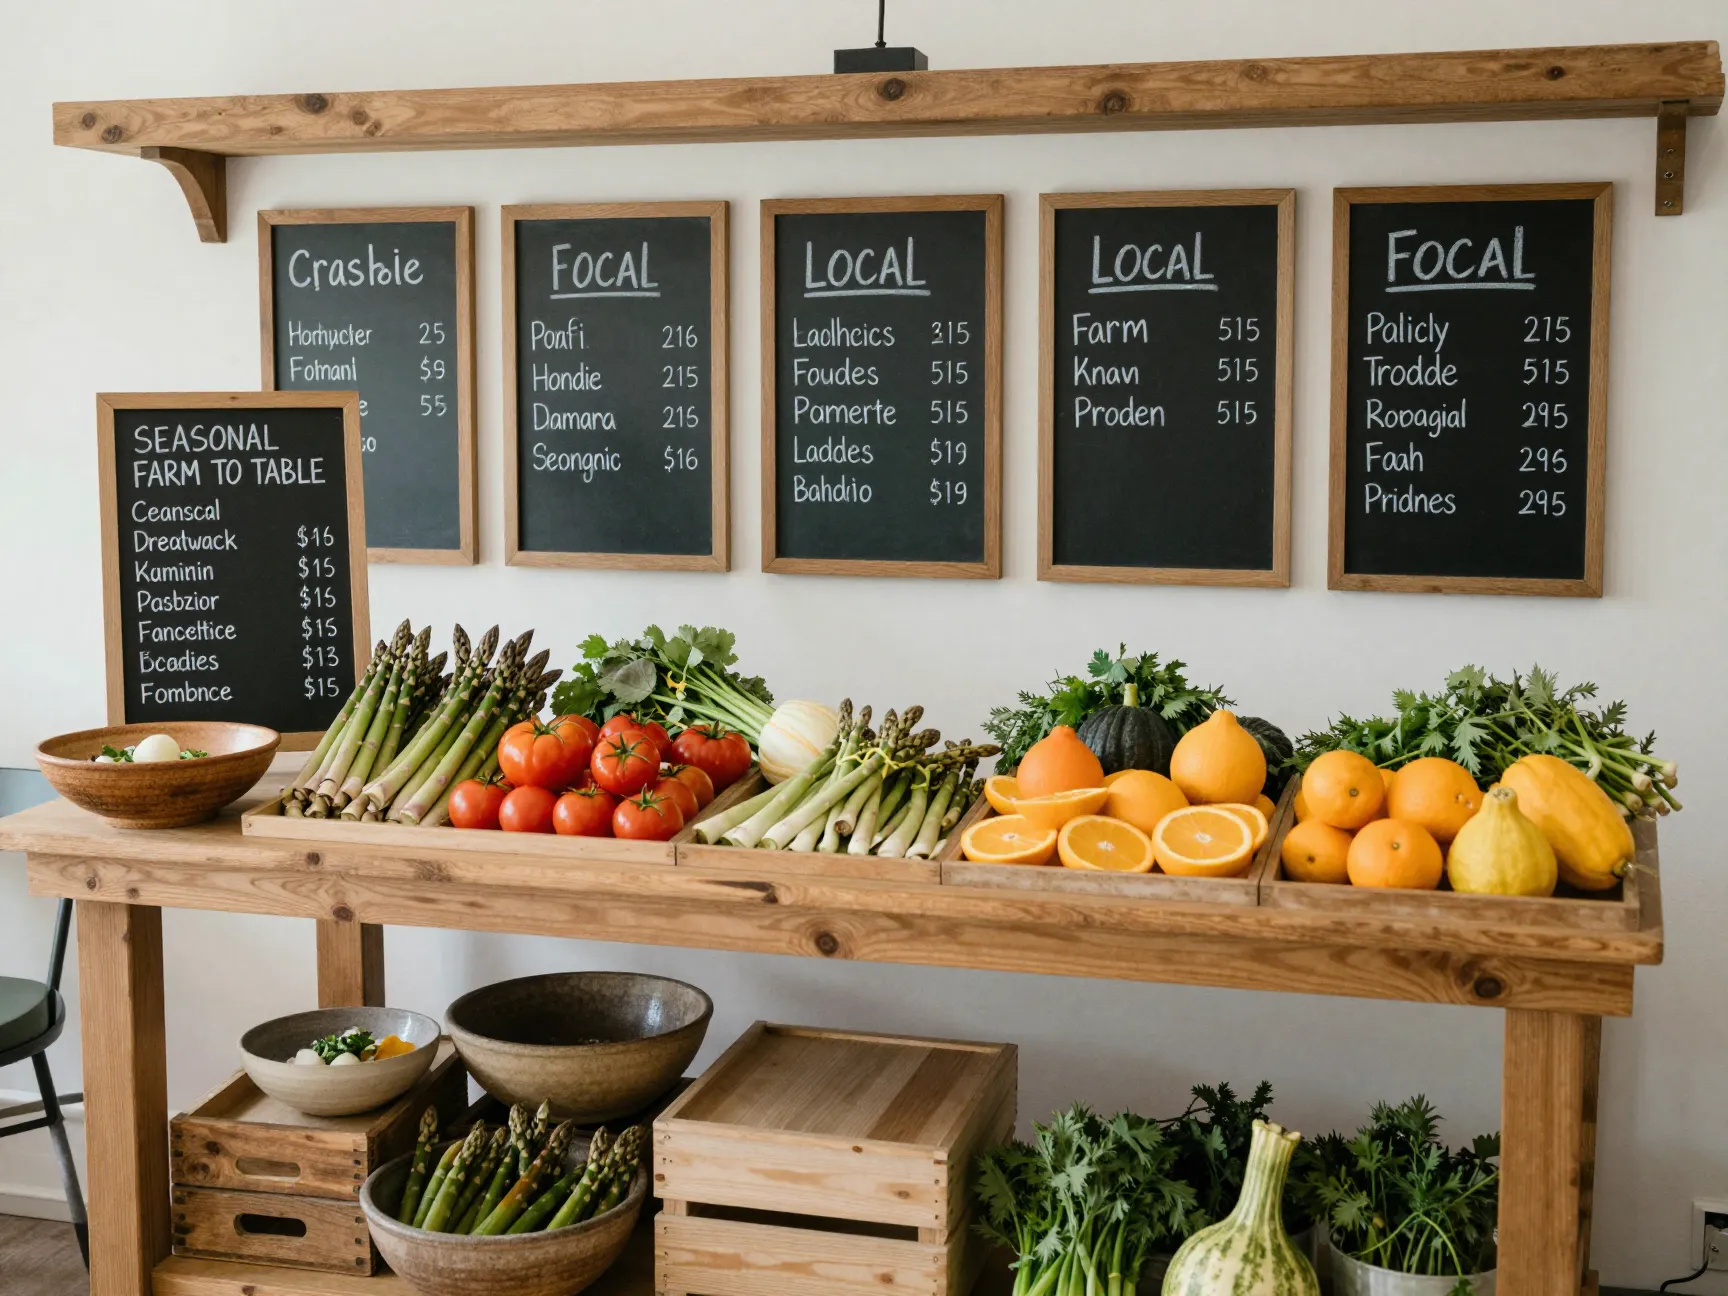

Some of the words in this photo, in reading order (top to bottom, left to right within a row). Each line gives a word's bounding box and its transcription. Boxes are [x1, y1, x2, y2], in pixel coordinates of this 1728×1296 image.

[552, 242, 659, 290] FOCAL
[805, 237, 926, 289] LOCAL
[1092, 232, 1214, 284] LOCAL
[1388, 226, 1534, 283] FOCAL
[418, 322, 446, 345] 25
[661, 325, 698, 349] 216
[1072, 312, 1148, 346] Farm
[1218, 316, 1260, 342] 515
[1523, 316, 1571, 343] 215
[532, 362, 603, 392] Hondie
[662, 365, 699, 388] 215
[793, 356, 879, 387] Foudes
[931, 360, 968, 385] 515
[1217, 357, 1259, 382] 515
[1363, 353, 1458, 386] Trodde
[1522, 358, 1569, 386] 515
[420, 394, 448, 417] 55
[532, 402, 617, 431] Damara
[794, 395, 897, 425] Pamerte
[930, 400, 968, 424] 515
[1074, 395, 1165, 428] Proden
[1217, 400, 1257, 425] 515
[1521, 402, 1568, 429] 295
[134, 423, 280, 454] SEASONAL
[793, 435, 874, 464] Laddes
[664, 445, 698, 473] $16
[1366, 441, 1423, 473] Faah
[133, 459, 201, 488] FARM
[210, 458, 243, 485] TO
[250, 457, 326, 485] TABLE
[1365, 482, 1456, 514] Pridnes
[1518, 489, 1566, 516] 295
[297, 524, 334, 550] $16
[137, 589, 220, 613] Pasbzior
[140, 680, 233, 704] Fombnce
[304, 675, 340, 701] $15
